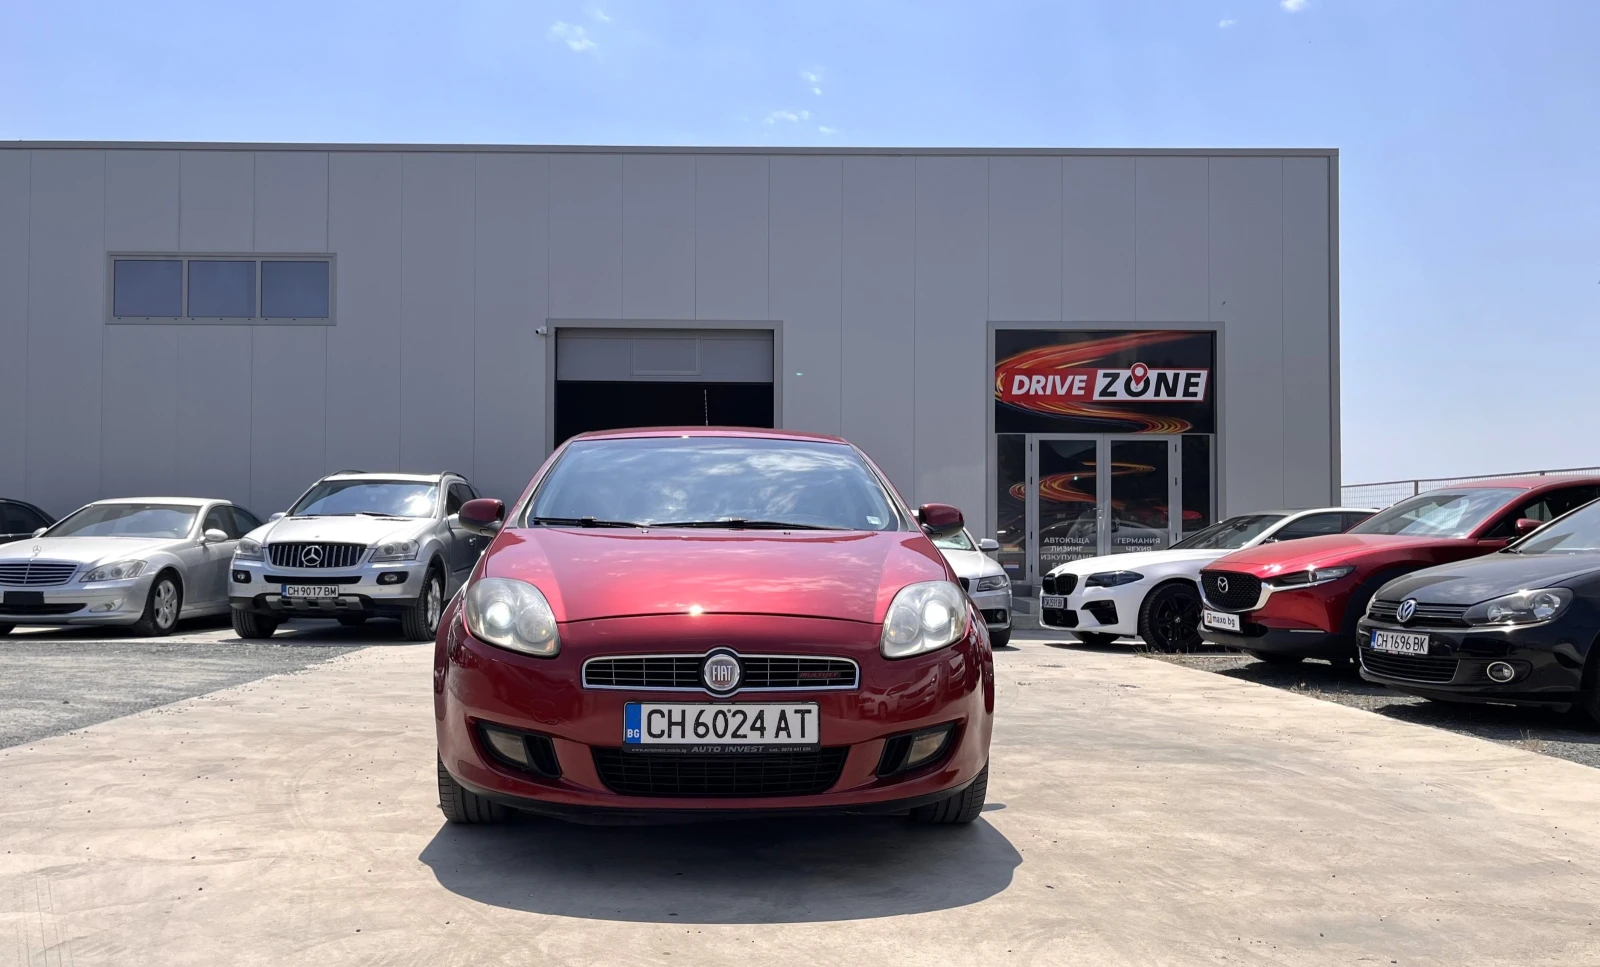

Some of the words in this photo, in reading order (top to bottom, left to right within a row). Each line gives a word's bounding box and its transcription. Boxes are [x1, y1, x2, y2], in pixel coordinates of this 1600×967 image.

[1011, 375, 1087, 396] DRIVE
[1098, 372, 1201, 398] ZONE
[287, 586, 299, 596] CH
[300, 586, 322, 596] 9017
[323, 586, 336, 596] BM
[1376, 633, 1388, 648] CH
[1390, 634, 1411, 650] 1696
[1412, 636, 1426, 652] BK
[712, 665, 733, 681] FIAT
[647, 709, 686, 738] CH
[693, 709, 766, 738] 6024
[774, 709, 812, 738] AT
[627, 729, 640, 738] BG
